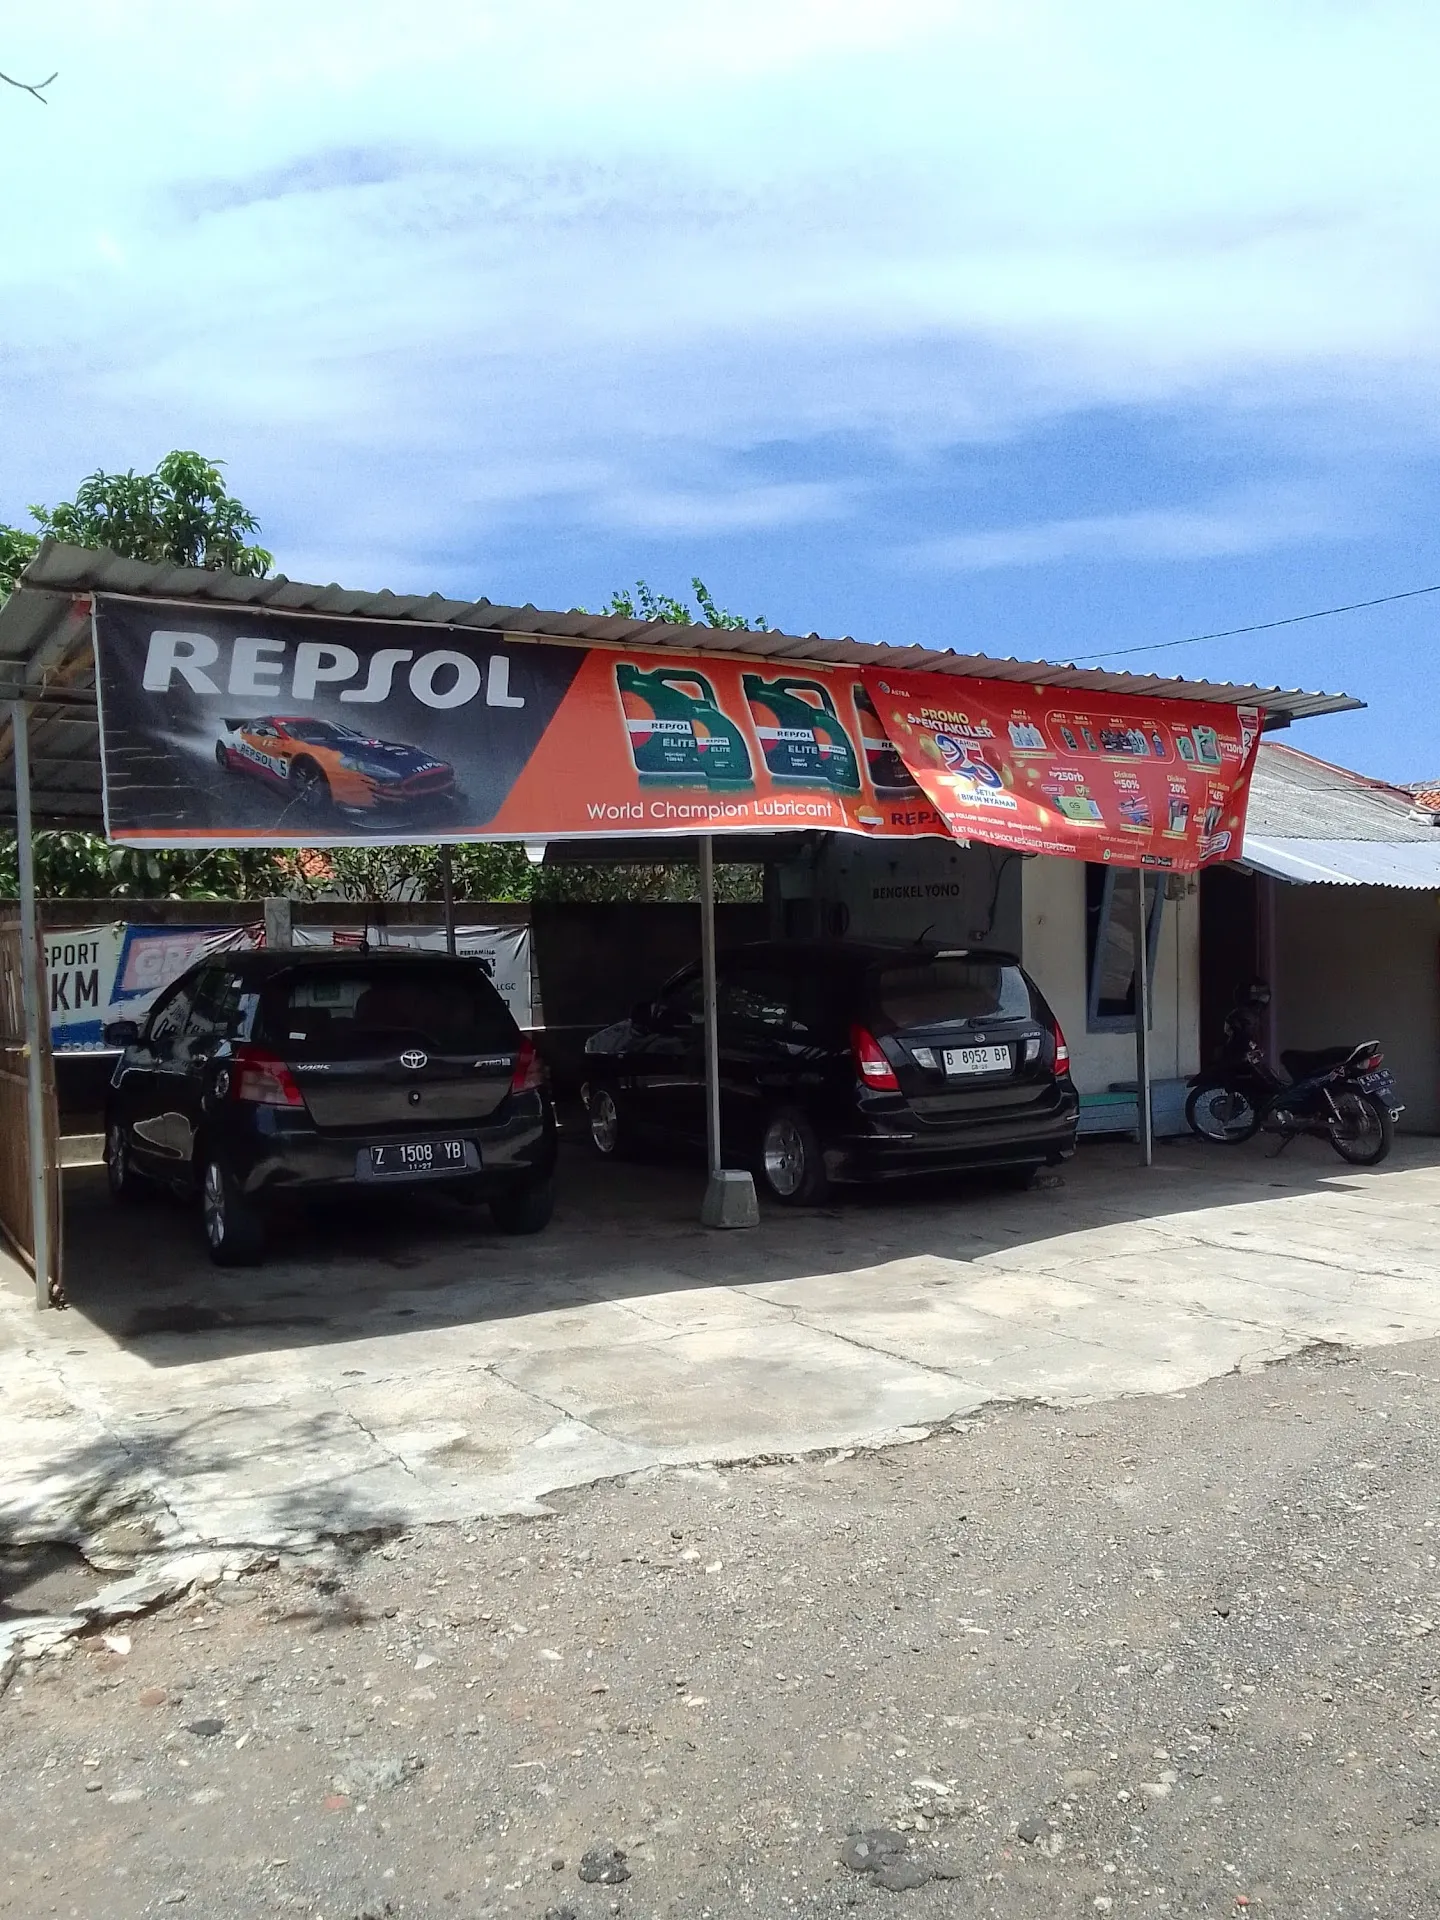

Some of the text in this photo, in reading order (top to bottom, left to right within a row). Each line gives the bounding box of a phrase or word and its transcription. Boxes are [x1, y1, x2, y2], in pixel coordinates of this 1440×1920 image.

[142, 630, 525, 709] REPSOL
[920, 707, 969, 725] PROMO
[651, 722, 690, 732] REPSOL
[907, 713, 996, 738] SPEKTAKULER
[777, 730, 812, 739] REPSOL
[662, 738, 696, 748] ELITE
[788, 744, 818, 755] ELITE
[955, 738, 979, 748] TAHUN
[934, 732, 1004, 790] 25
[279, 759, 287, 778] 5
[1113, 770, 1137, 779] Diskon
[1166, 774, 1187, 783] Diskon
[975, 788, 996, 797] SETIA
[1169, 783, 1187, 794] 20%
[961, 794, 1016, 808] BIKIN NYAMAN
[586, 799, 832, 820] World Champion Lubricant
[891, 812, 942, 826] REPS
[873, 884, 960, 899] BENGKEL YONO
[43, 942, 99, 968] SPORT
[51, 968, 99, 1012] KM
[946, 1048, 1007, 1065] B 8952 BP
[374, 1142, 461, 1165] Z 1508 YB
